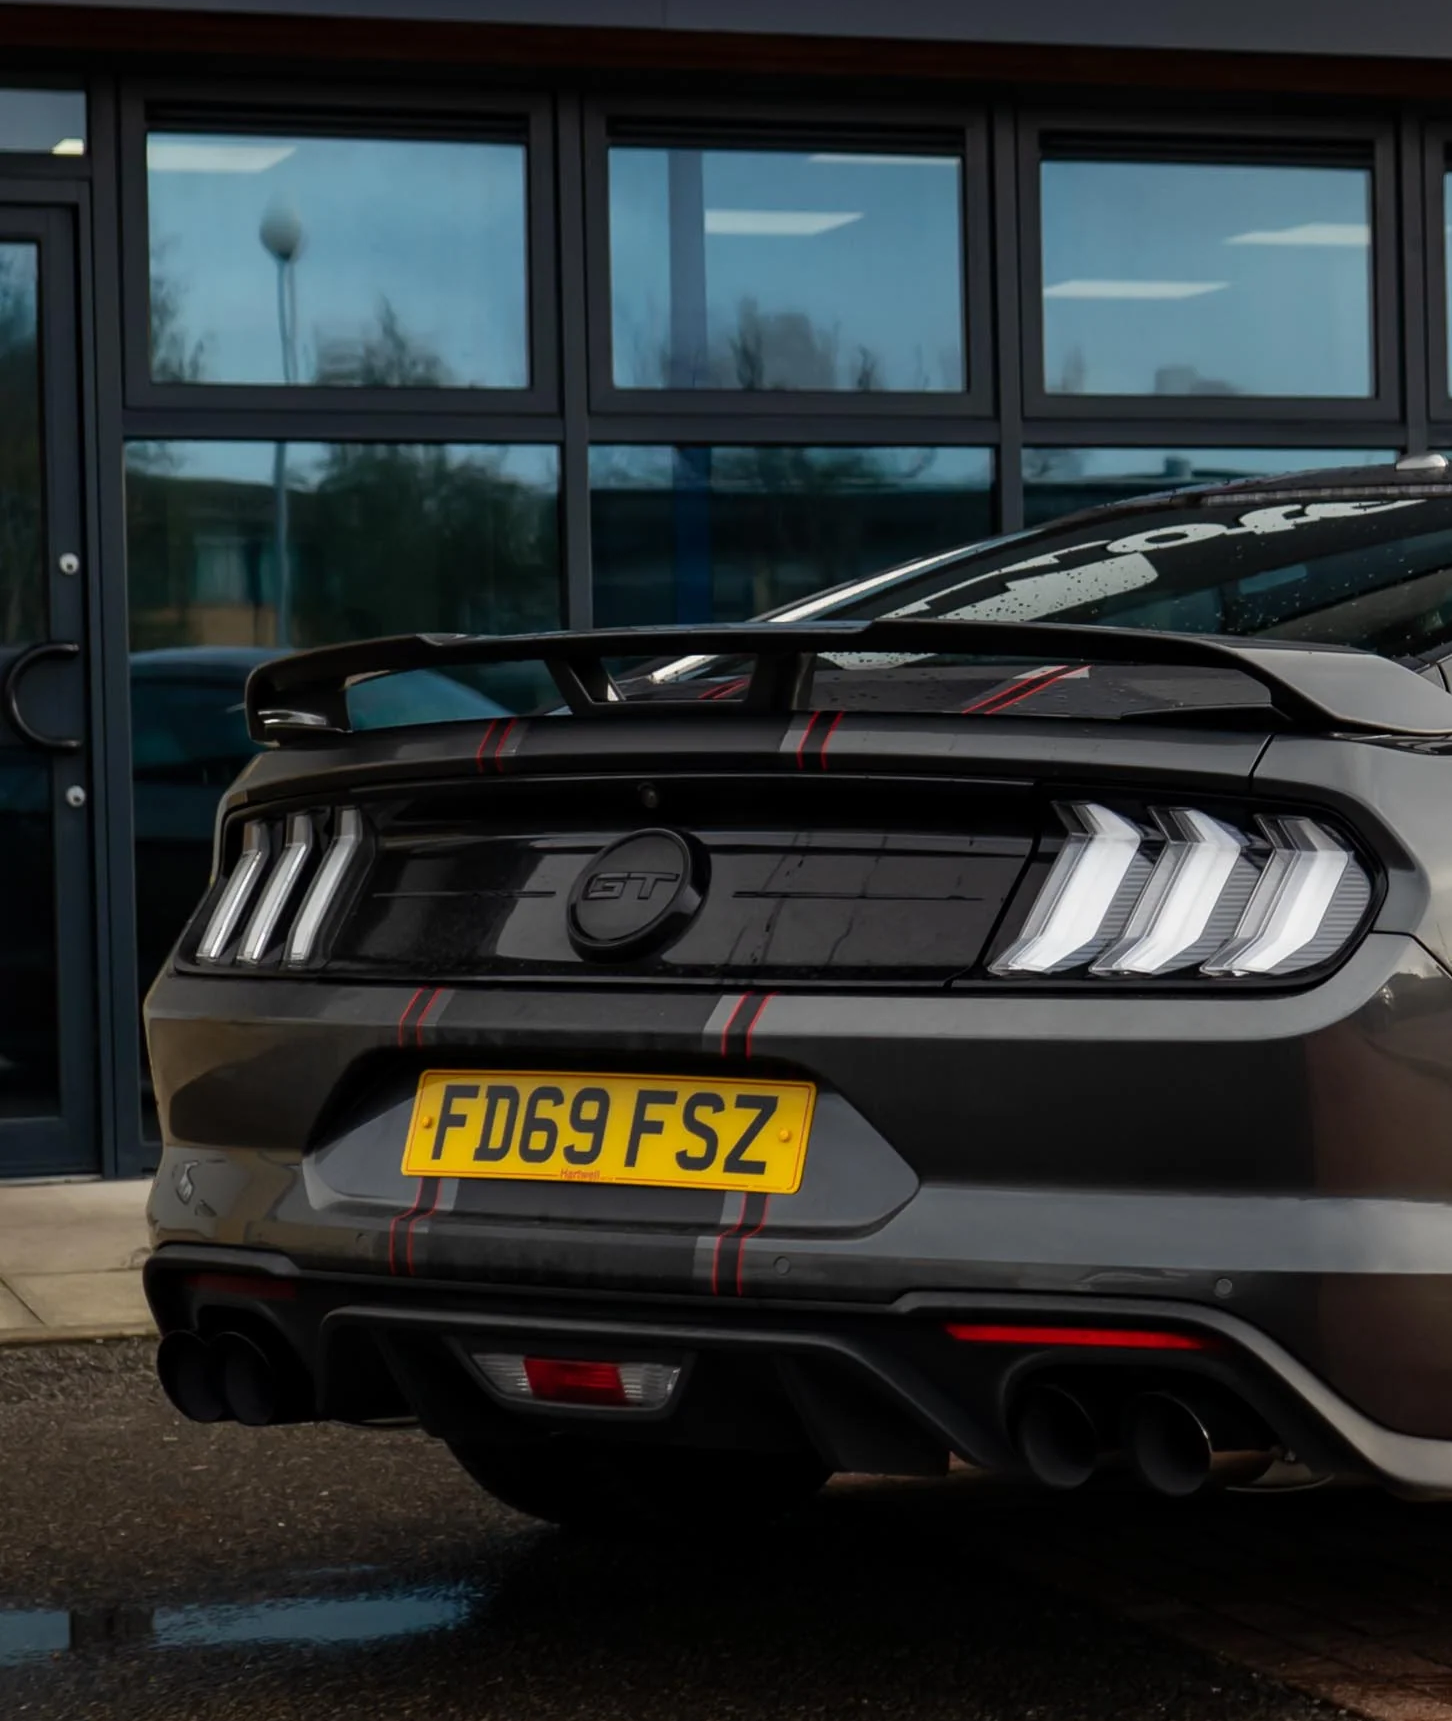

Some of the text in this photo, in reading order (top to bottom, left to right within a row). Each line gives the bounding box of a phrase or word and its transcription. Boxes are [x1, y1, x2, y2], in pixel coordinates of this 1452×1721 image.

[583, 872, 680, 901] GT
[430, 1084, 780, 1175] FD69 FSZ
